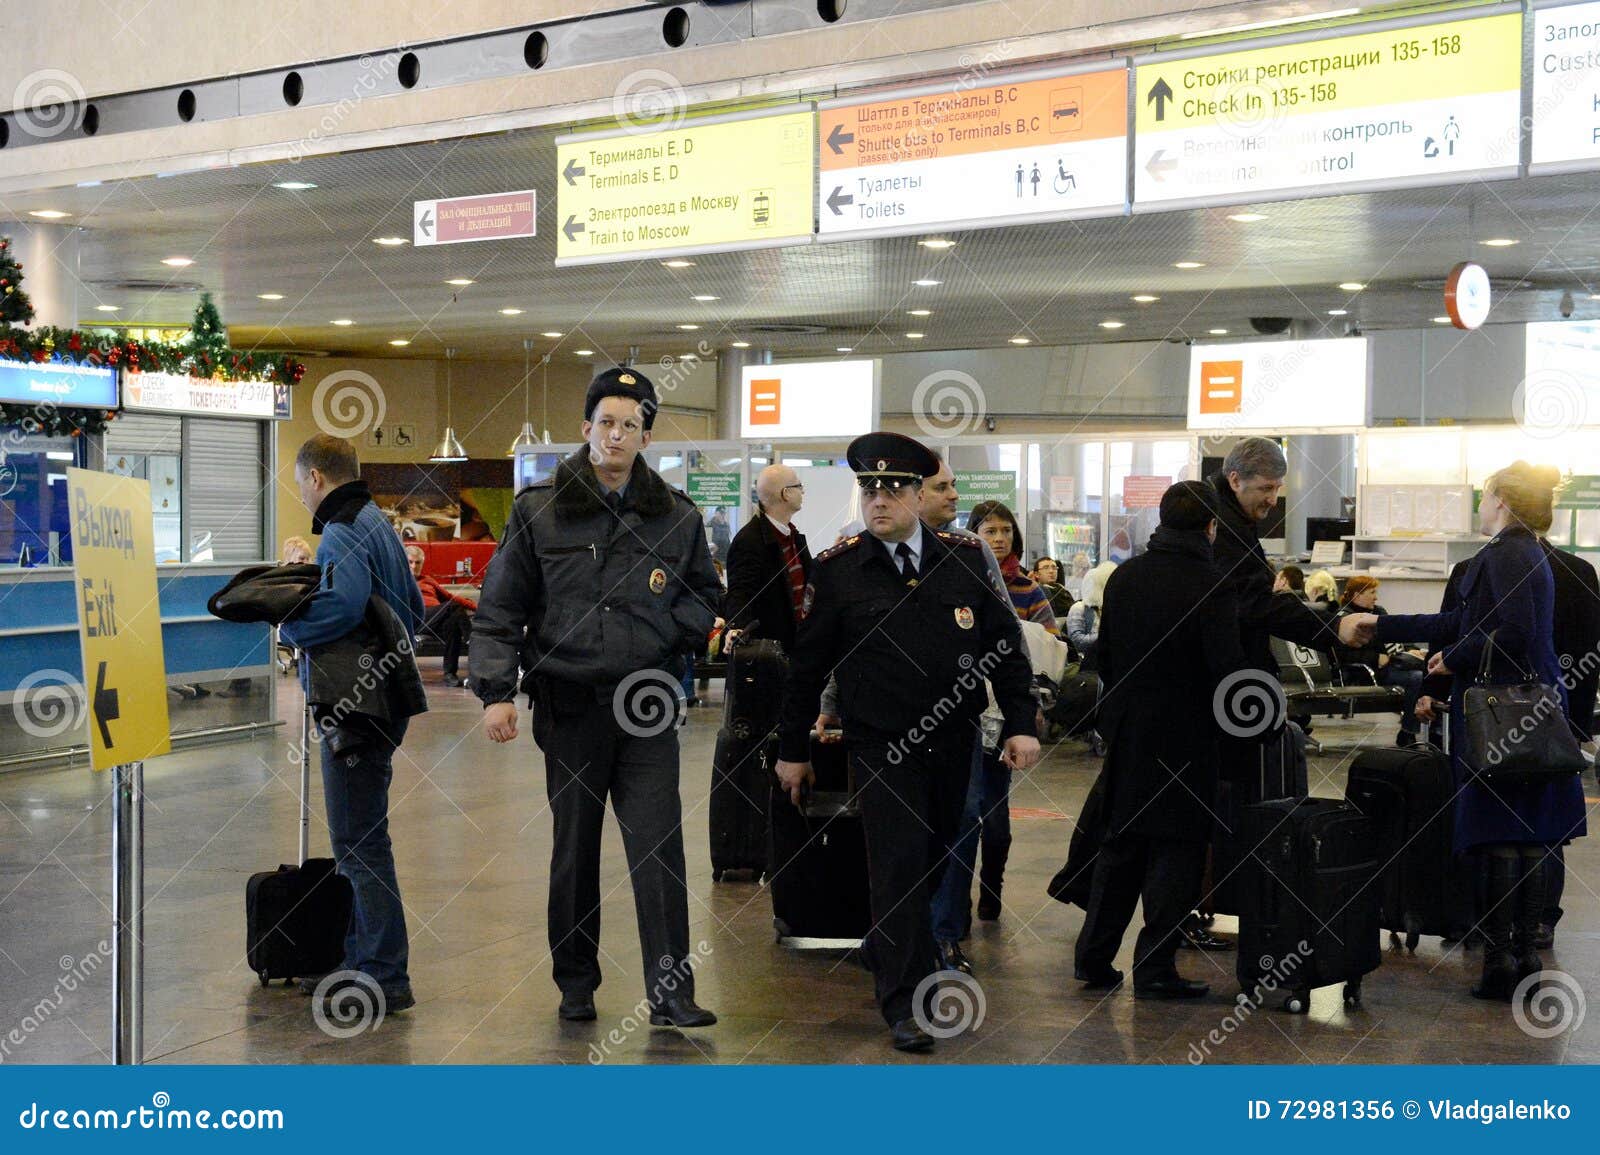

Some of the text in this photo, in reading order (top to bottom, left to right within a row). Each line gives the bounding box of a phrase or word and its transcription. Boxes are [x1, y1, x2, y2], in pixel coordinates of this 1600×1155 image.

[1183, 34, 1461, 90] Стойки регистрации 135-158
[858, 107, 898, 123] Шаттл
[901, 105, 909, 117] в
[913, 95, 989, 115] Терминалы
[1183, 82, 1337, 117] Check In 135-158
[858, 123, 892, 136] (только
[895, 119, 913, 129] для
[858, 139, 901, 154] Shuttle
[904, 134, 928, 148] bus
[931, 132, 944, 145] to
[949, 120, 1012, 141] Terminals
[1322, 120, 1413, 144] контроль
[589, 138, 694, 167] Терминалы E, D
[915, 145, 938, 158] only)
[1292, 152, 1354, 175] ontrol
[589, 164, 679, 190] Terminals E, D
[858, 174, 922, 197] Туалеты
[588, 194, 739, 222] Электропоезд в Москву
[858, 200, 905, 219] Toilets
[589, 224, 690, 246] Train to Moscow
[75, 486, 136, 560] Выход
[82, 577, 117, 637] Exit
